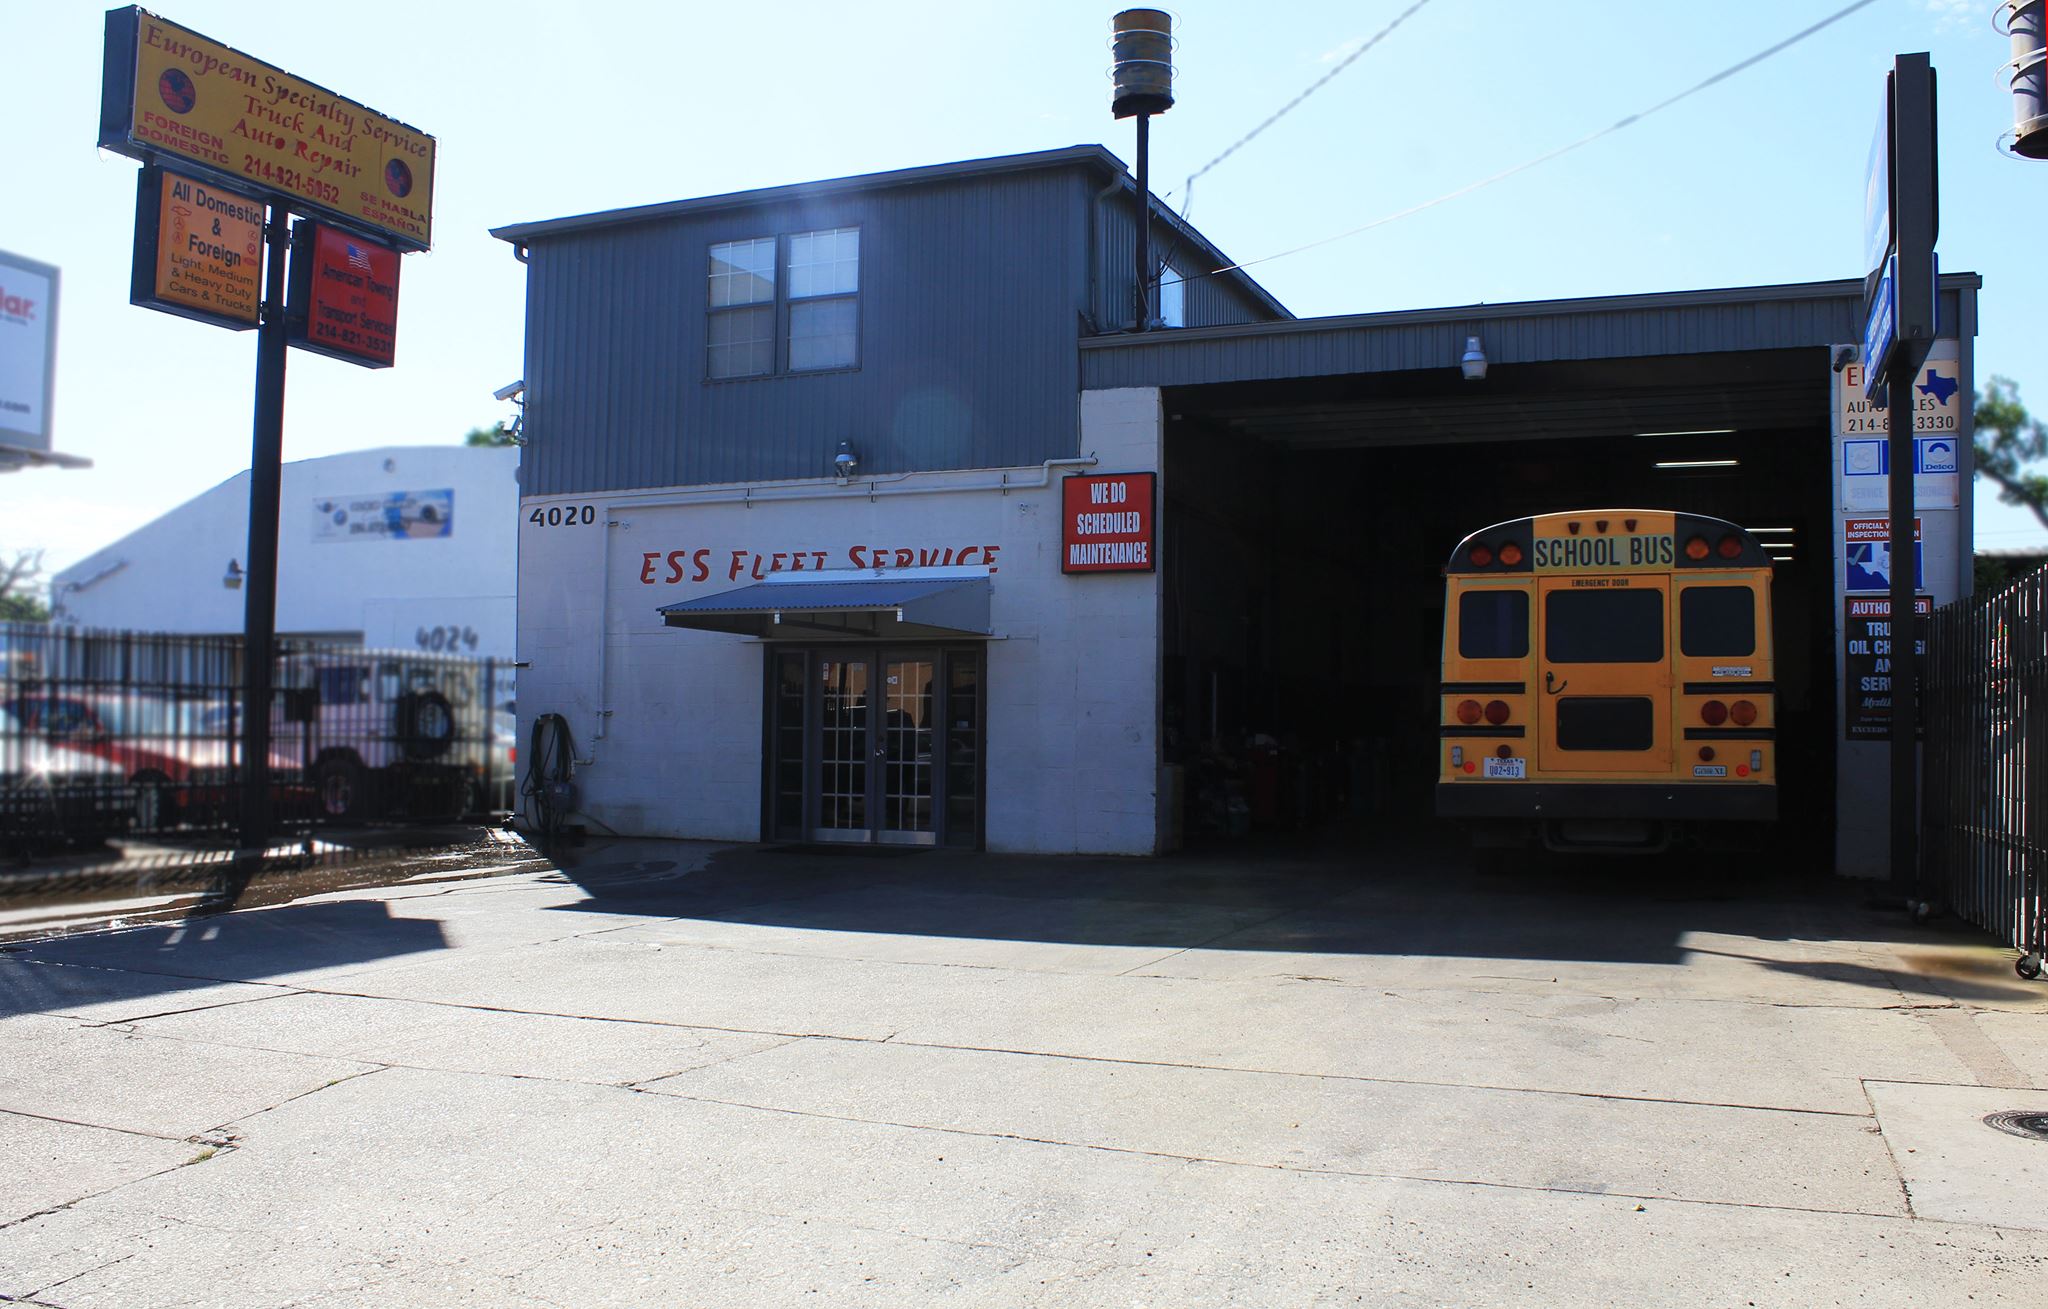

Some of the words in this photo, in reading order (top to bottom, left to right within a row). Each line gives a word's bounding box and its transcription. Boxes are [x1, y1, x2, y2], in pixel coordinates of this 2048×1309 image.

[144, 23, 257, 88] European
[262, 75, 354, 135] Specialty
[361, 117, 427, 157] Service
[143, 111, 224, 150] FOREIGN
[244, 94, 304, 134] Truck
[310, 124, 358, 153] And
[136, 125, 230, 164] DOMESTIC
[231, 118, 286, 150] Auto
[293, 140, 361, 178] Repair
[172, 181, 190, 202] All
[196, 188, 262, 226] Domestic
[359, 191, 376, 205] SE
[381, 199, 427, 224] HABLA
[211, 217, 221, 237] &
[188, 234, 241, 267] Foreign
[171, 267, 180, 278] &
[185, 270, 222, 291] Heavy
[226, 283, 252, 301] Duty
[208, 264, 254, 286] Medium
[169, 280, 198, 297] Cars
[201, 290, 210, 302] &
[214, 293, 253, 313] Trucks
[1090, 482, 1109, 504] WE
[1111, 481, 1127, 503] DO
[529, 505, 596, 527] 4020
[1076, 511, 1141, 535] SCHEDULED
[1848, 531, 1889, 539] INSPECTION
[639, 549, 711, 586] ESS
[1070, 541, 1148, 565] MAINTENANCE
[1535, 538, 1621, 567] SCHOOL
[1630, 536, 1674, 565] BUS
[1571, 579, 1610, 587] EMERGENCY
[1611, 578, 1629, 587] DOOR
[415, 624, 479, 652] 4024
[1848, 640, 1871, 655] OIL
